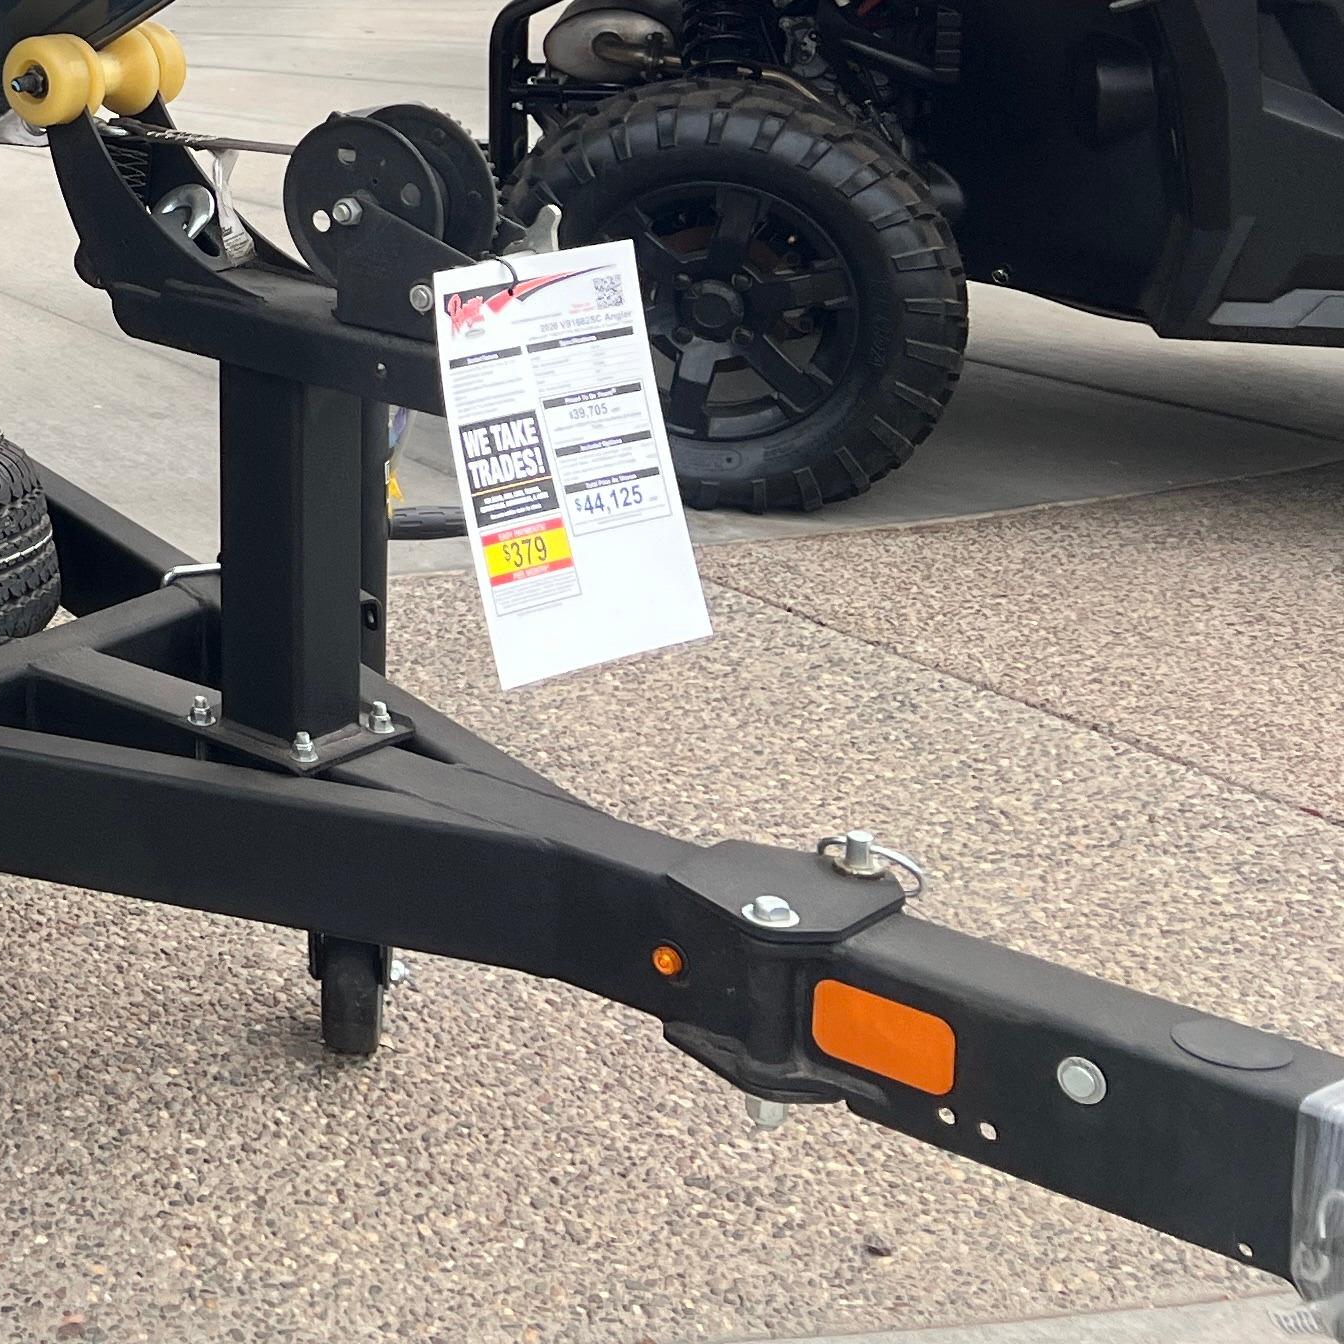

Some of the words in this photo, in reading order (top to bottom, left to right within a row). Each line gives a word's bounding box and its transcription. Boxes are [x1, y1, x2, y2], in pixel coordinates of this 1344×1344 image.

[462, 426, 492, 459] WE
[490, 417, 540, 454] TAKE
[468, 446, 546, 490] TRADES!
[574, 484, 644, 515] $44,125
[502, 535, 548, 568] $379
